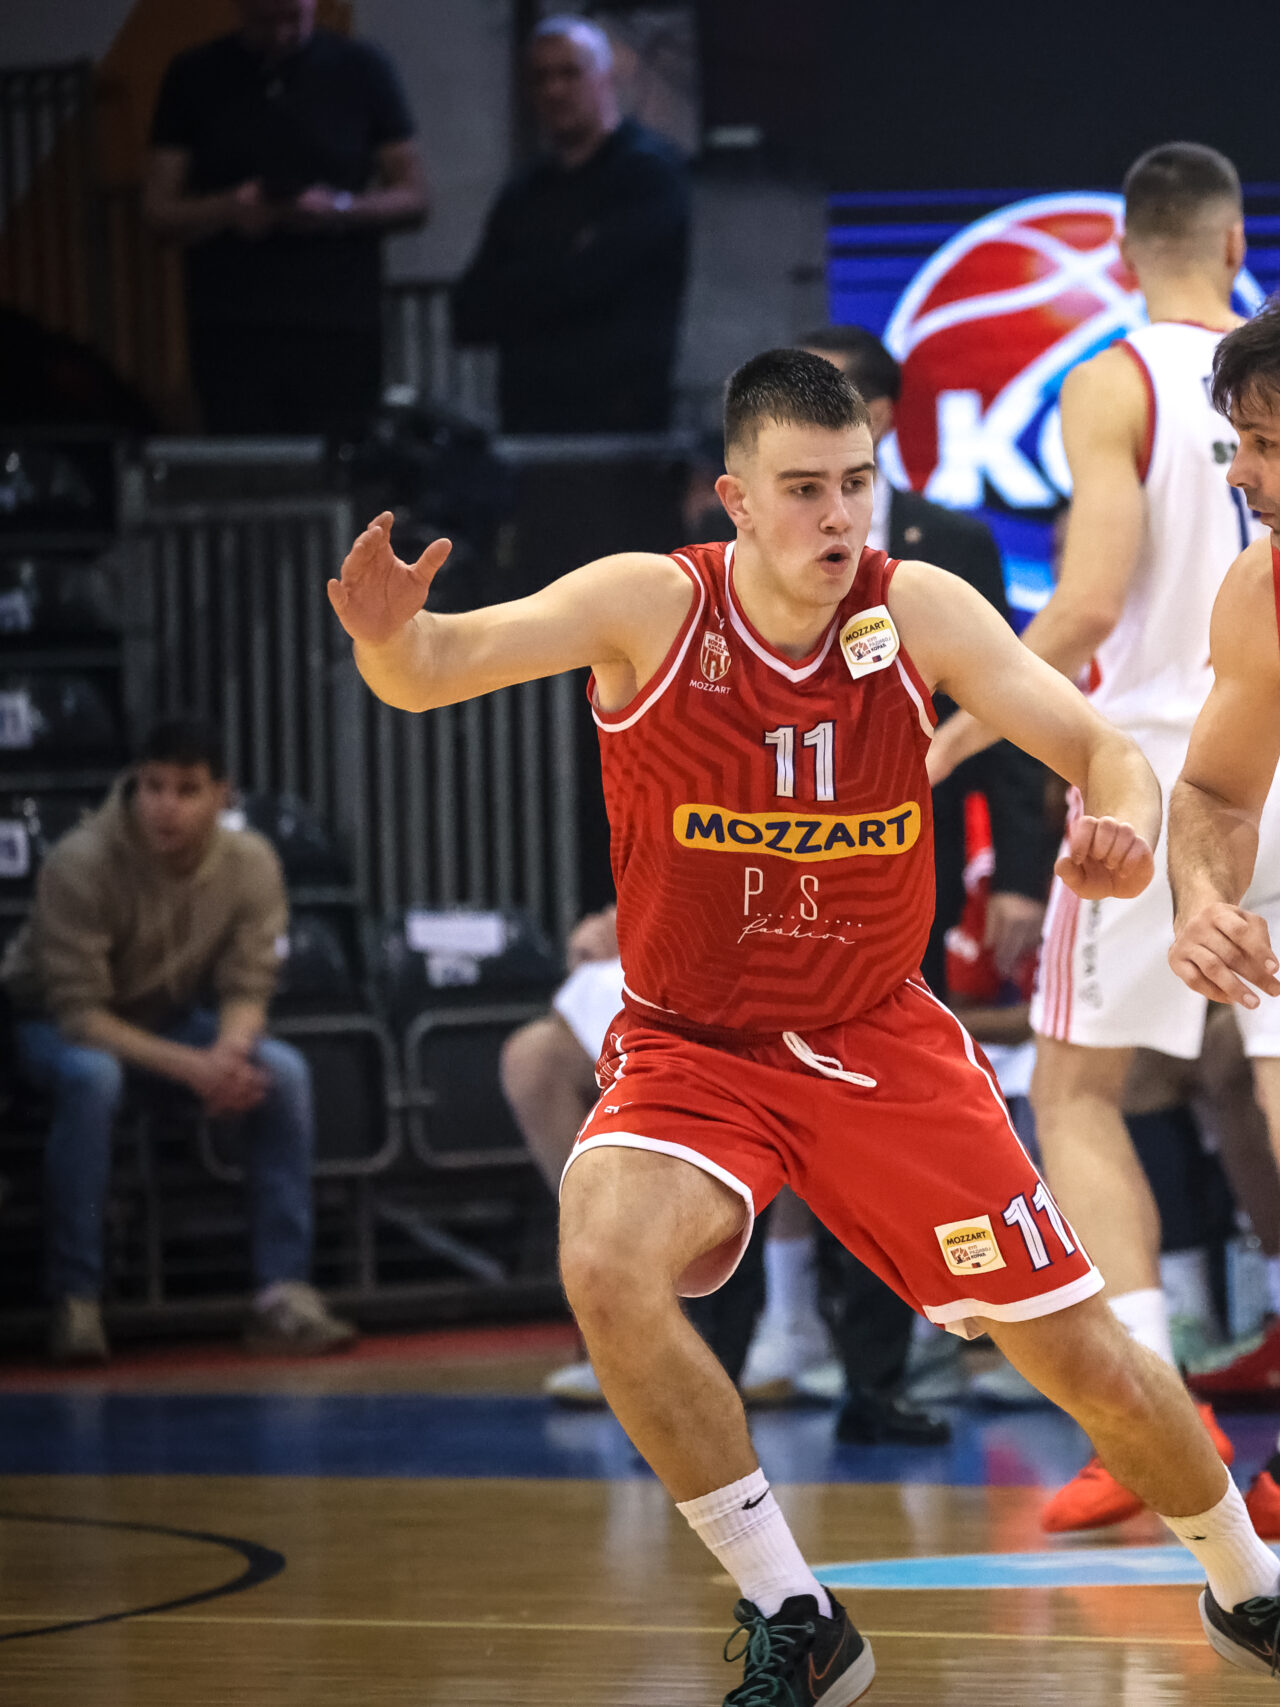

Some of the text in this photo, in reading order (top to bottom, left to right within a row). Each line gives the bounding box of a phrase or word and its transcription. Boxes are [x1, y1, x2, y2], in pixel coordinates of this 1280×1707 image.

[845, 620, 885, 643] MOZZART
[689, 680, 732, 694] MOZZART
[764, 720, 836, 802] 11
[685, 810, 913, 854] MOZZART
[737, 918, 856, 944] fashion
[946, 1231, 986, 1245] MOZZART
[1000, 1181, 1076, 1272] 11
